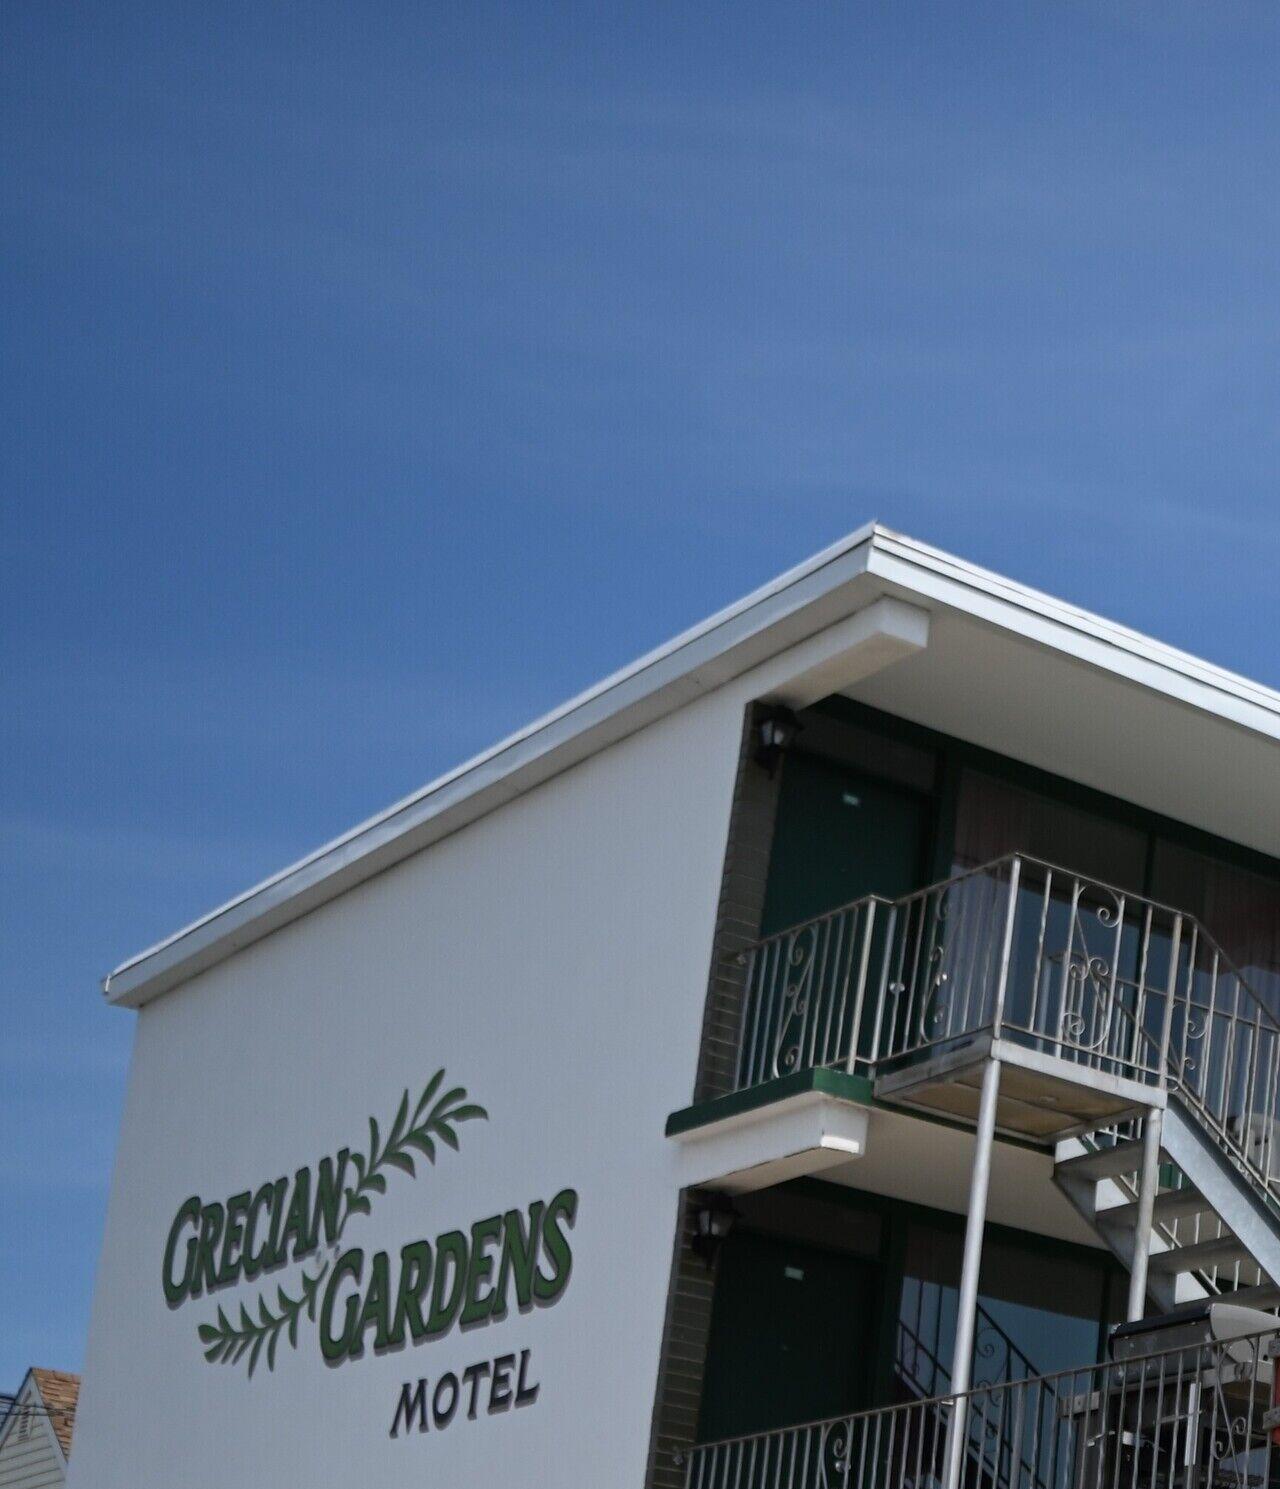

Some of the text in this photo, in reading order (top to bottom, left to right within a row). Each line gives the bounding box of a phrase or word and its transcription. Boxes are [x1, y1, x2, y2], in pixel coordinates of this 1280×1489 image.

[162, 1148, 351, 1310] GRECIAN
[319, 1188, 579, 1369] GARDENS
[389, 1348, 540, 1439] MOTEL
